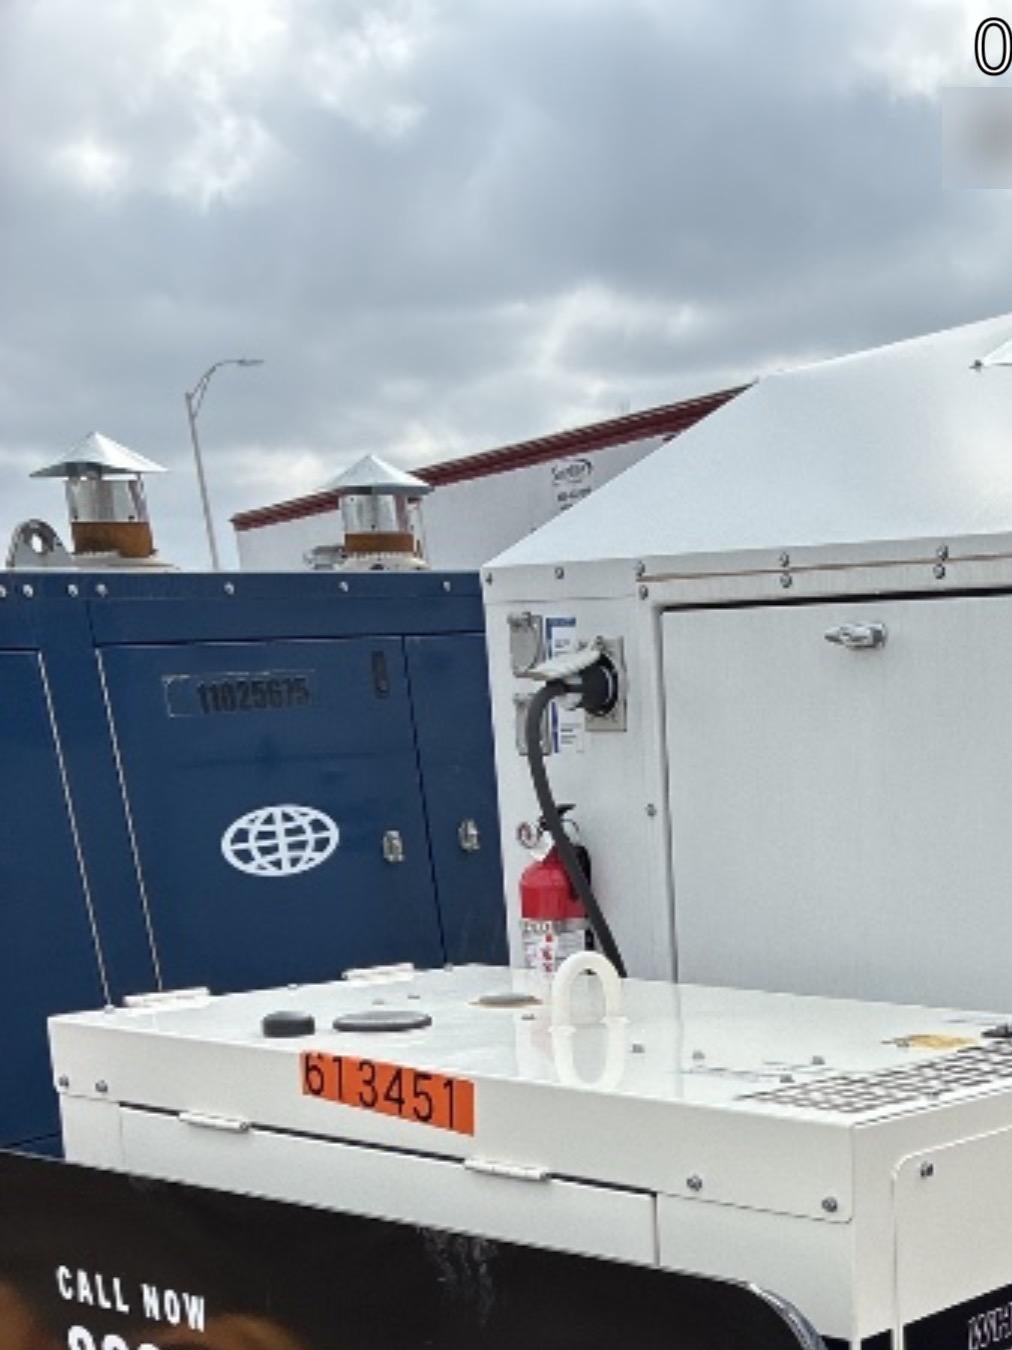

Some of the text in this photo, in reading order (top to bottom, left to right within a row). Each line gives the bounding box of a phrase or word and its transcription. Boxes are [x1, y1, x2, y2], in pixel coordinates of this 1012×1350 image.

[303, 1052, 459, 1131] 613451
[56, 1265, 207, 1333] CALL NOW
